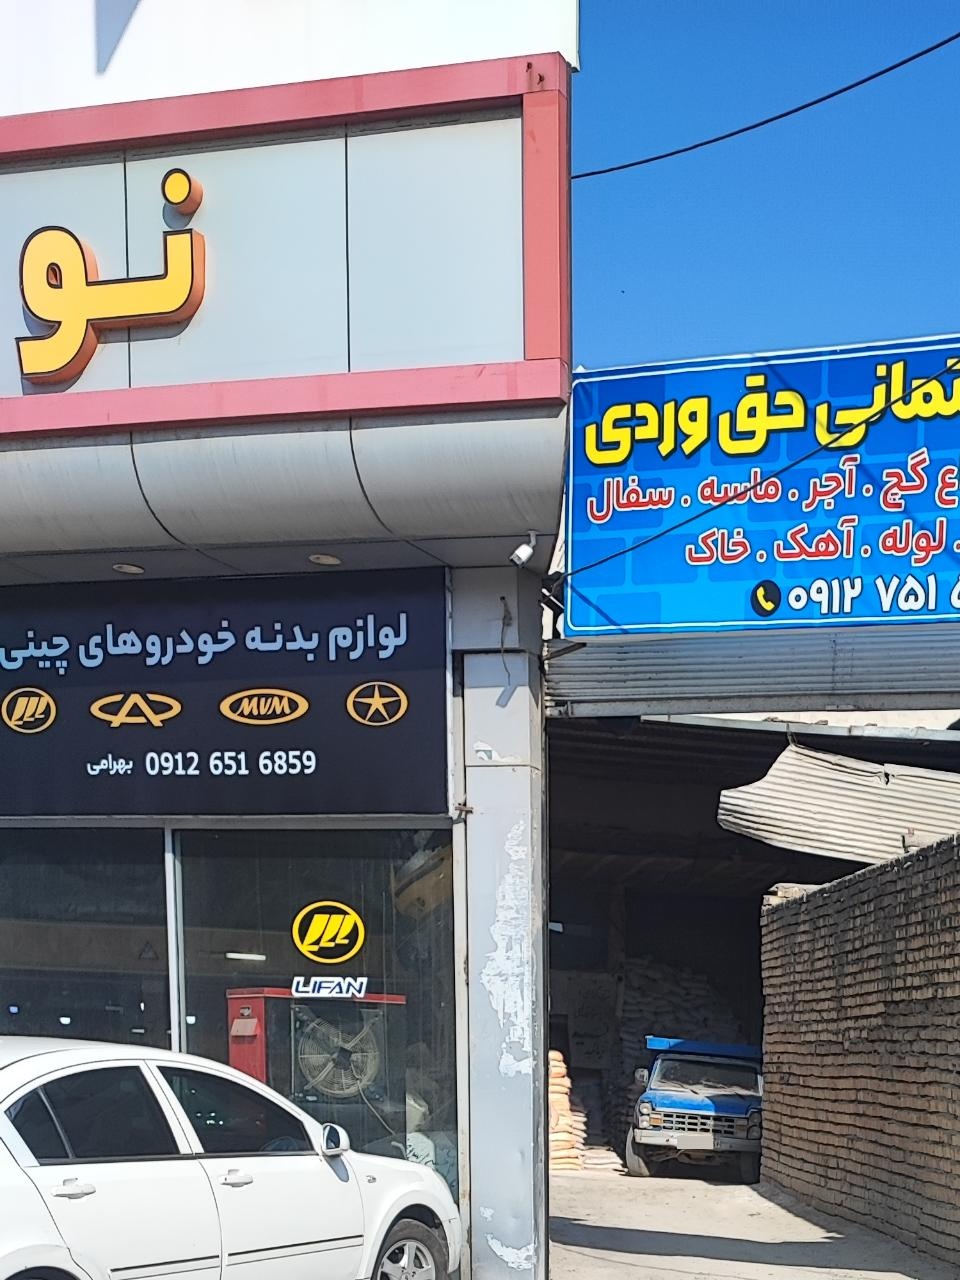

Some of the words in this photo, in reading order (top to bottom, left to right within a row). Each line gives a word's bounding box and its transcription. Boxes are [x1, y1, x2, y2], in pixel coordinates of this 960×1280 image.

[15, 168, 206, 384] نو
[584, 397, 708, 465] وردی
[718, 374, 806, 455] حق
[587, 475, 675, 524] سفال
[699, 468, 782, 505] ماسه
[803, 455, 860, 512] آجر
[880, 448, 930, 511] گچ
[685, 528, 753, 566] خاک
[773, 517, 858, 563] آهک
[878, 516, 947, 567] لوله
[787, 576, 863, 615] ۰۹۱۲
[874, 573, 937, 612] ۷۵۱
[0, 630, 71, 675] چینی
[78, 619, 237, 668] خودروهای
[245, 622, 319, 661] بدنه
[328, 613, 408, 661] لوازم
[235, 695, 292, 717] MVM
[87, 752, 134, 776] بهرامی
[145, 750, 201, 776] 0912
[208, 750, 250, 776] 651
[257, 750, 316, 775] 6859
[292, 976, 368, 998] LIFAN
